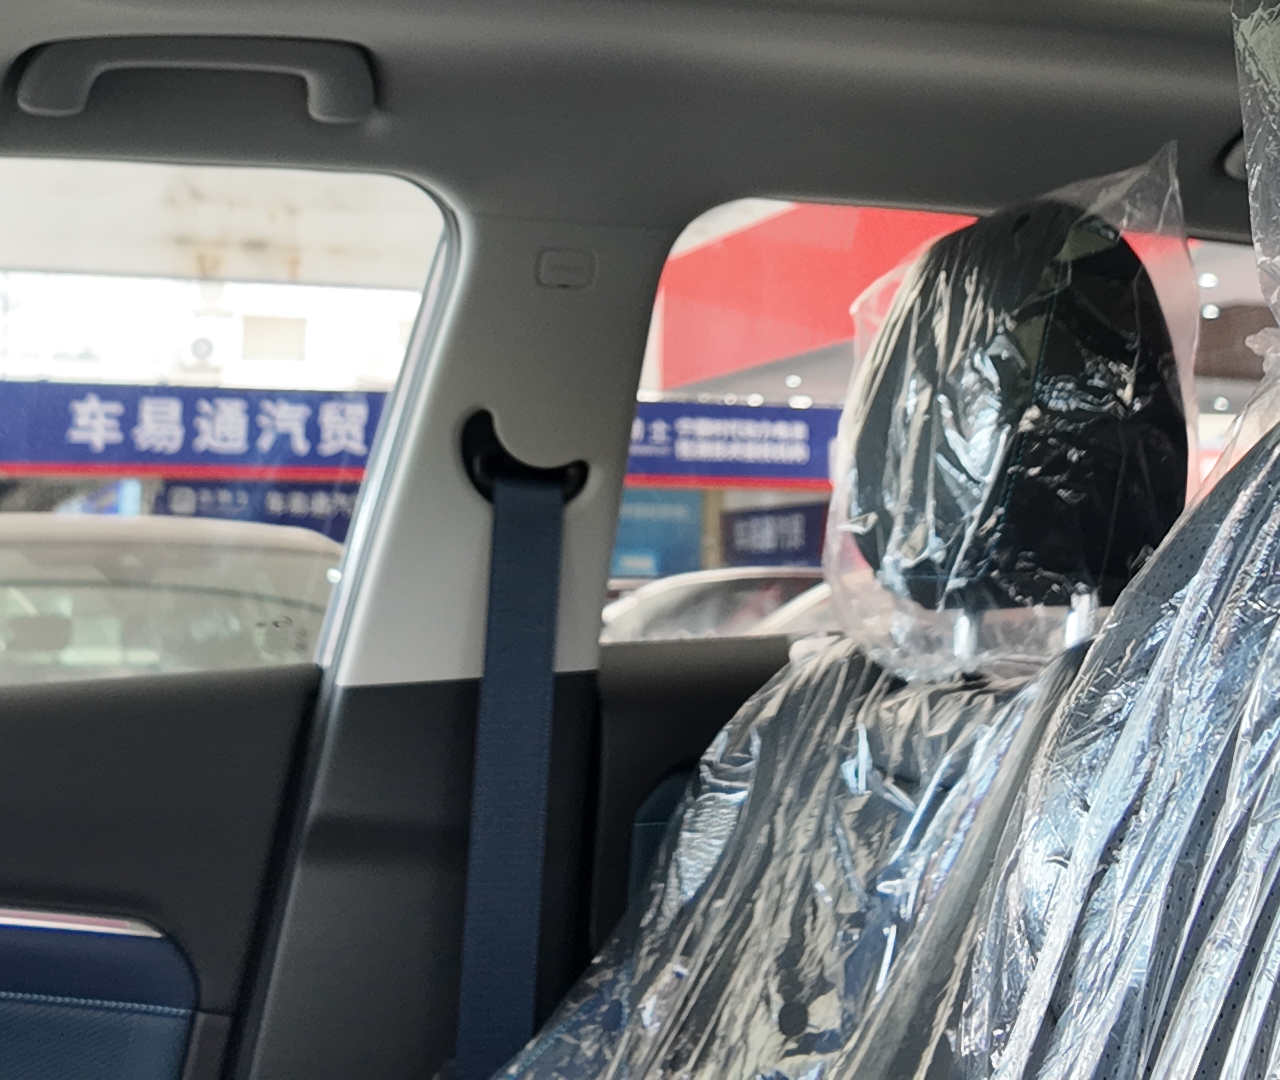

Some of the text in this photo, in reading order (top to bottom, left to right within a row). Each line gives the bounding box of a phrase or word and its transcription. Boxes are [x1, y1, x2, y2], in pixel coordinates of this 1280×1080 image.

[65, 392, 370, 457] 车易通汽贸
